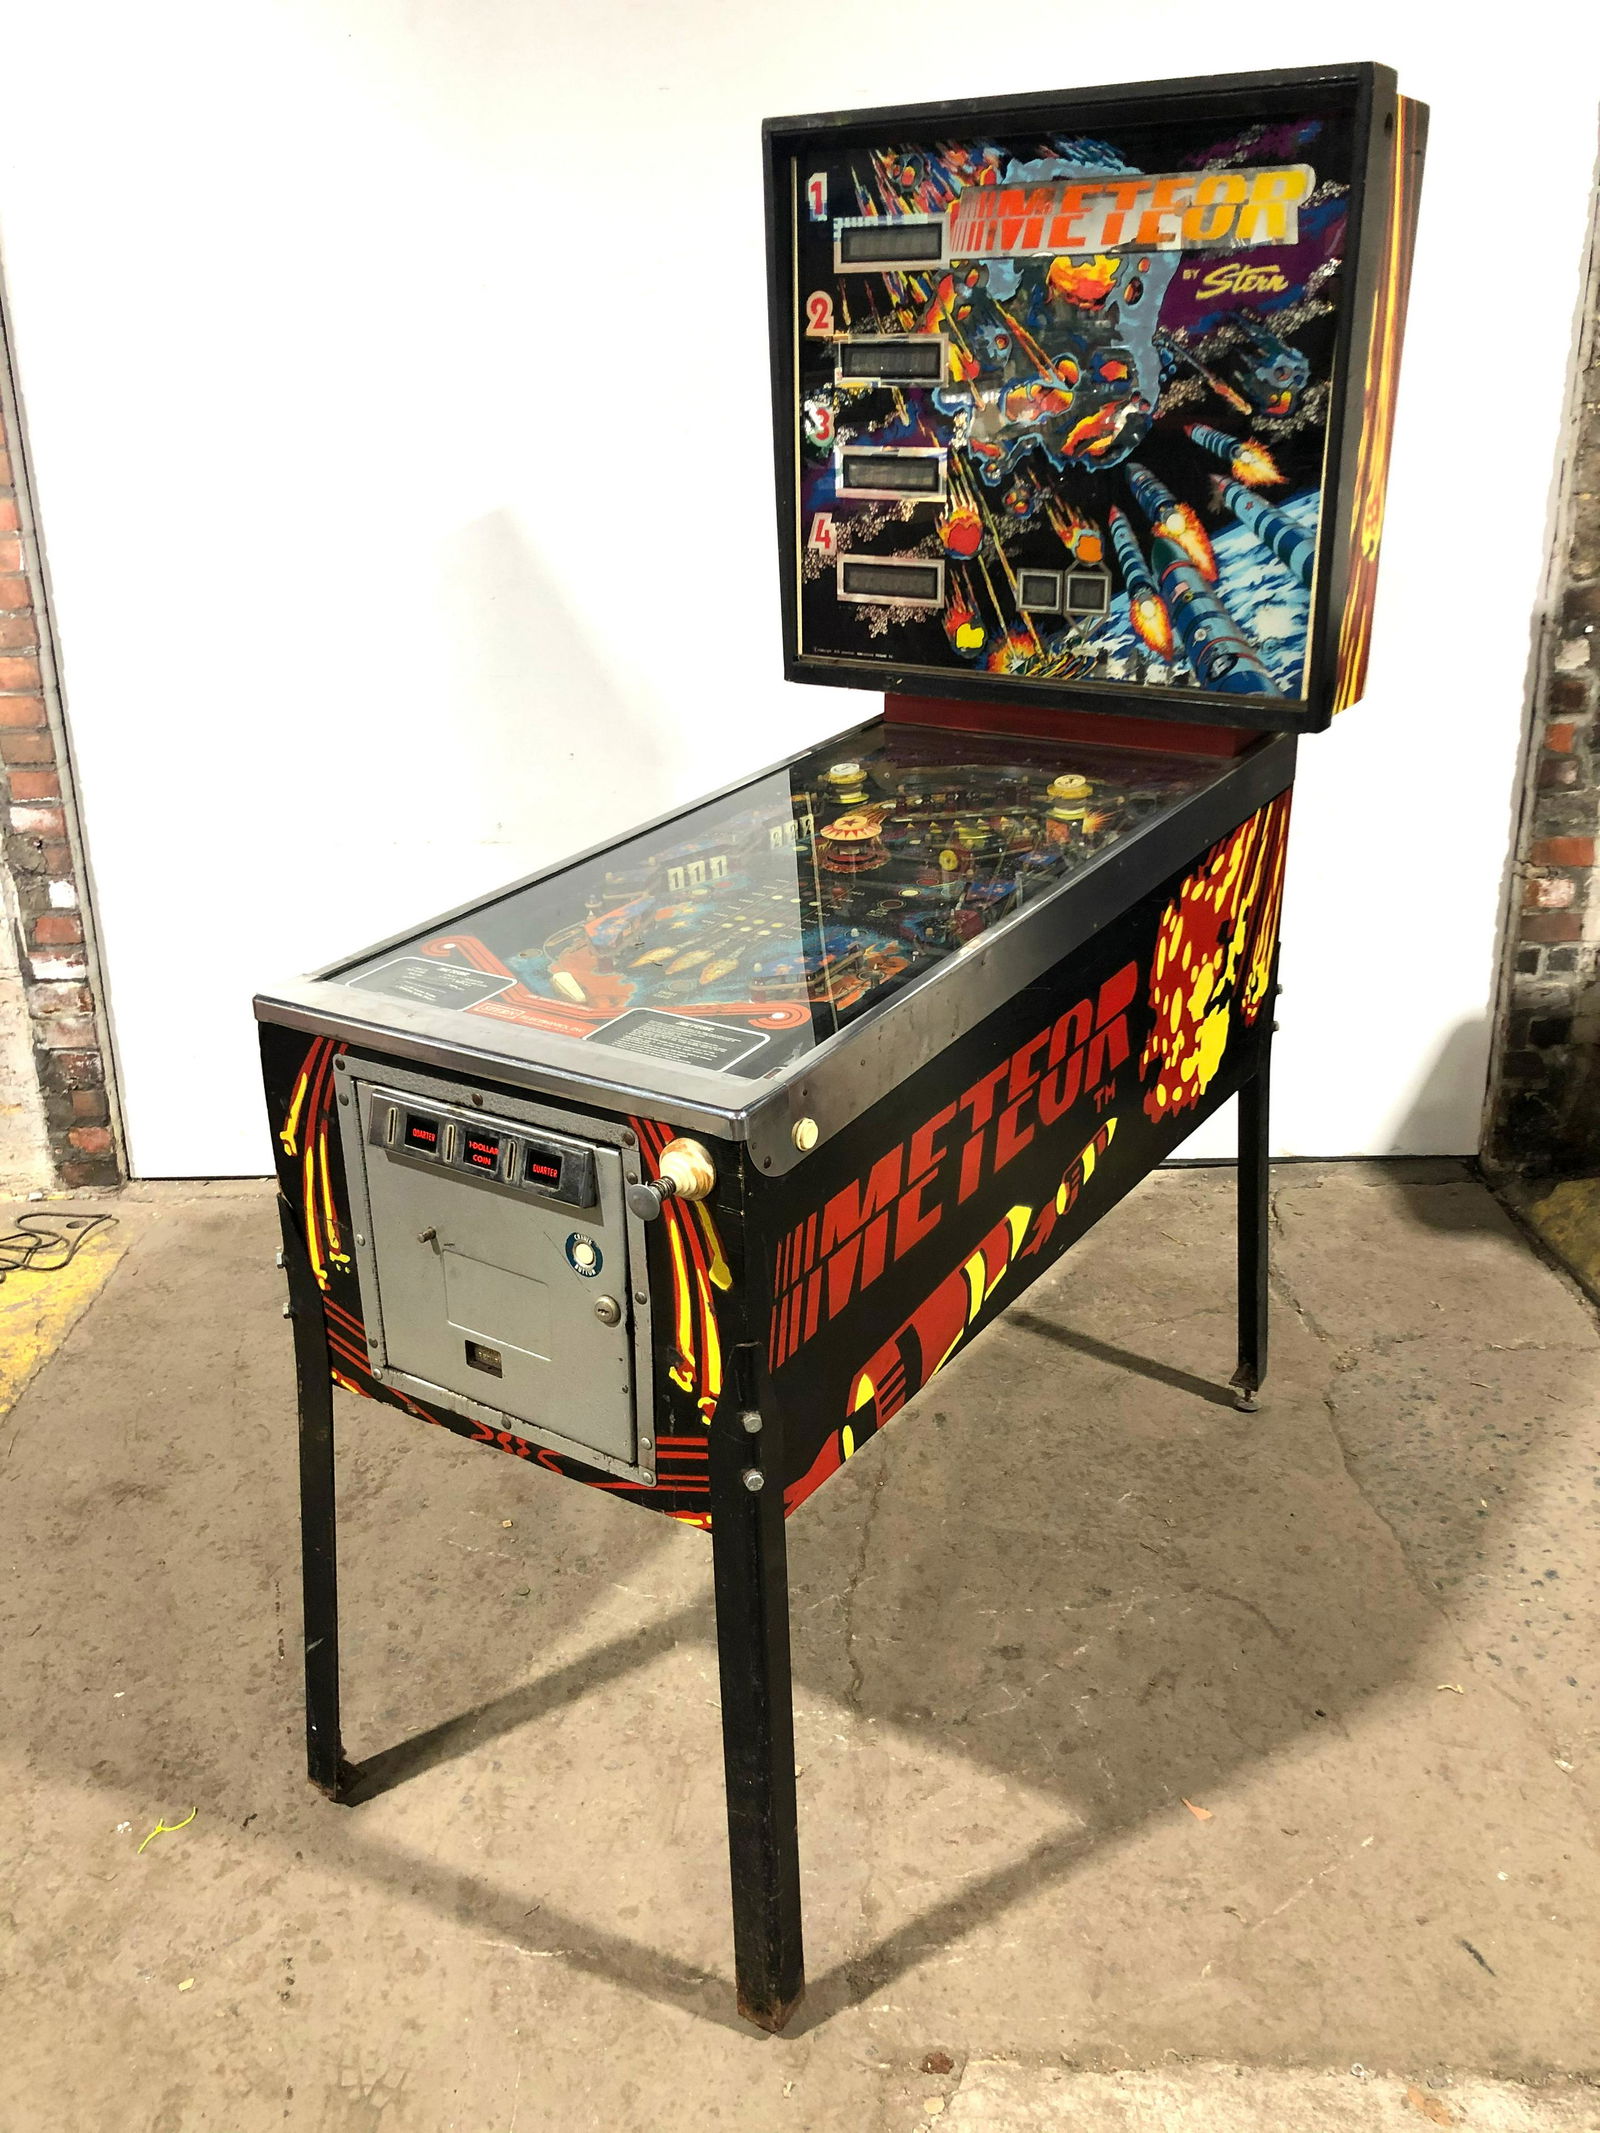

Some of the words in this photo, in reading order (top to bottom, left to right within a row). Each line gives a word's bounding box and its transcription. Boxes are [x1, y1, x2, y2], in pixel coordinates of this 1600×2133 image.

[809, 178, 825, 218] 1
[999, 170, 1307, 250] METEOR
[1182, 268, 1200, 280] BY
[1195, 262, 1289, 300] Stern
[809, 295, 831, 331] 2
[813, 405, 832, 443] 3
[813, 517, 833, 550] 4
[1092, 1077, 1116, 1113] TM
[411, 1127, 437, 1143] QUARTER
[819, 959, 1139, 1321] METEOR
[472, 1153, 492, 1166] COIN
[532, 1162, 558, 1179] QUARTER
